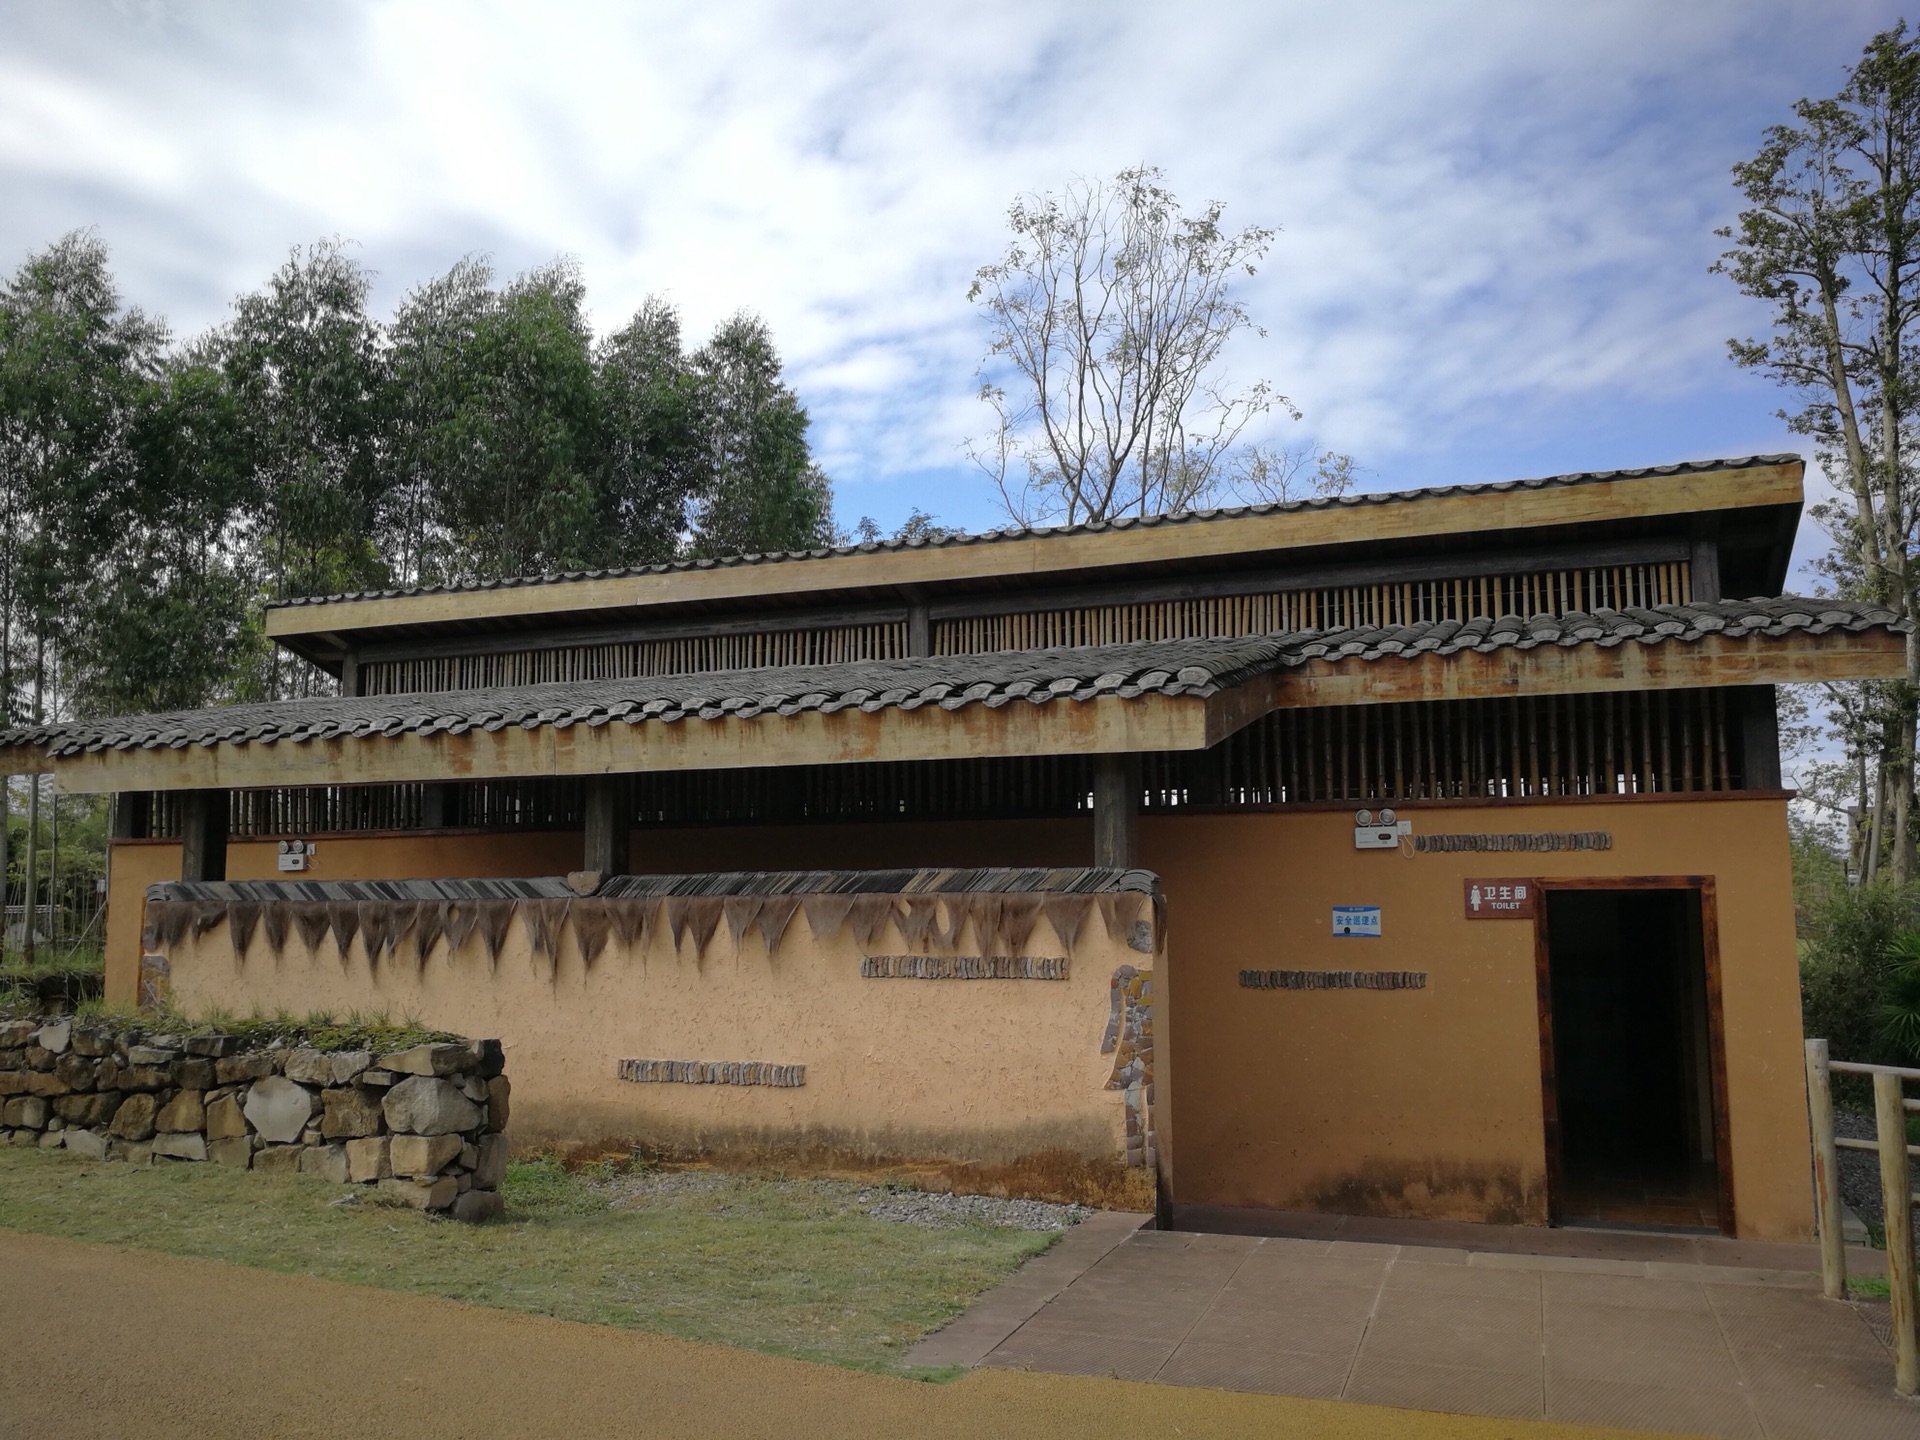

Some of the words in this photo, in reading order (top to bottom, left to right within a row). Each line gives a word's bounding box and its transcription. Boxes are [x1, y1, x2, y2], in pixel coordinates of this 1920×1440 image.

[1483, 886, 1527, 900] 卫生间
[1491, 902, 1521, 910] TOILET
